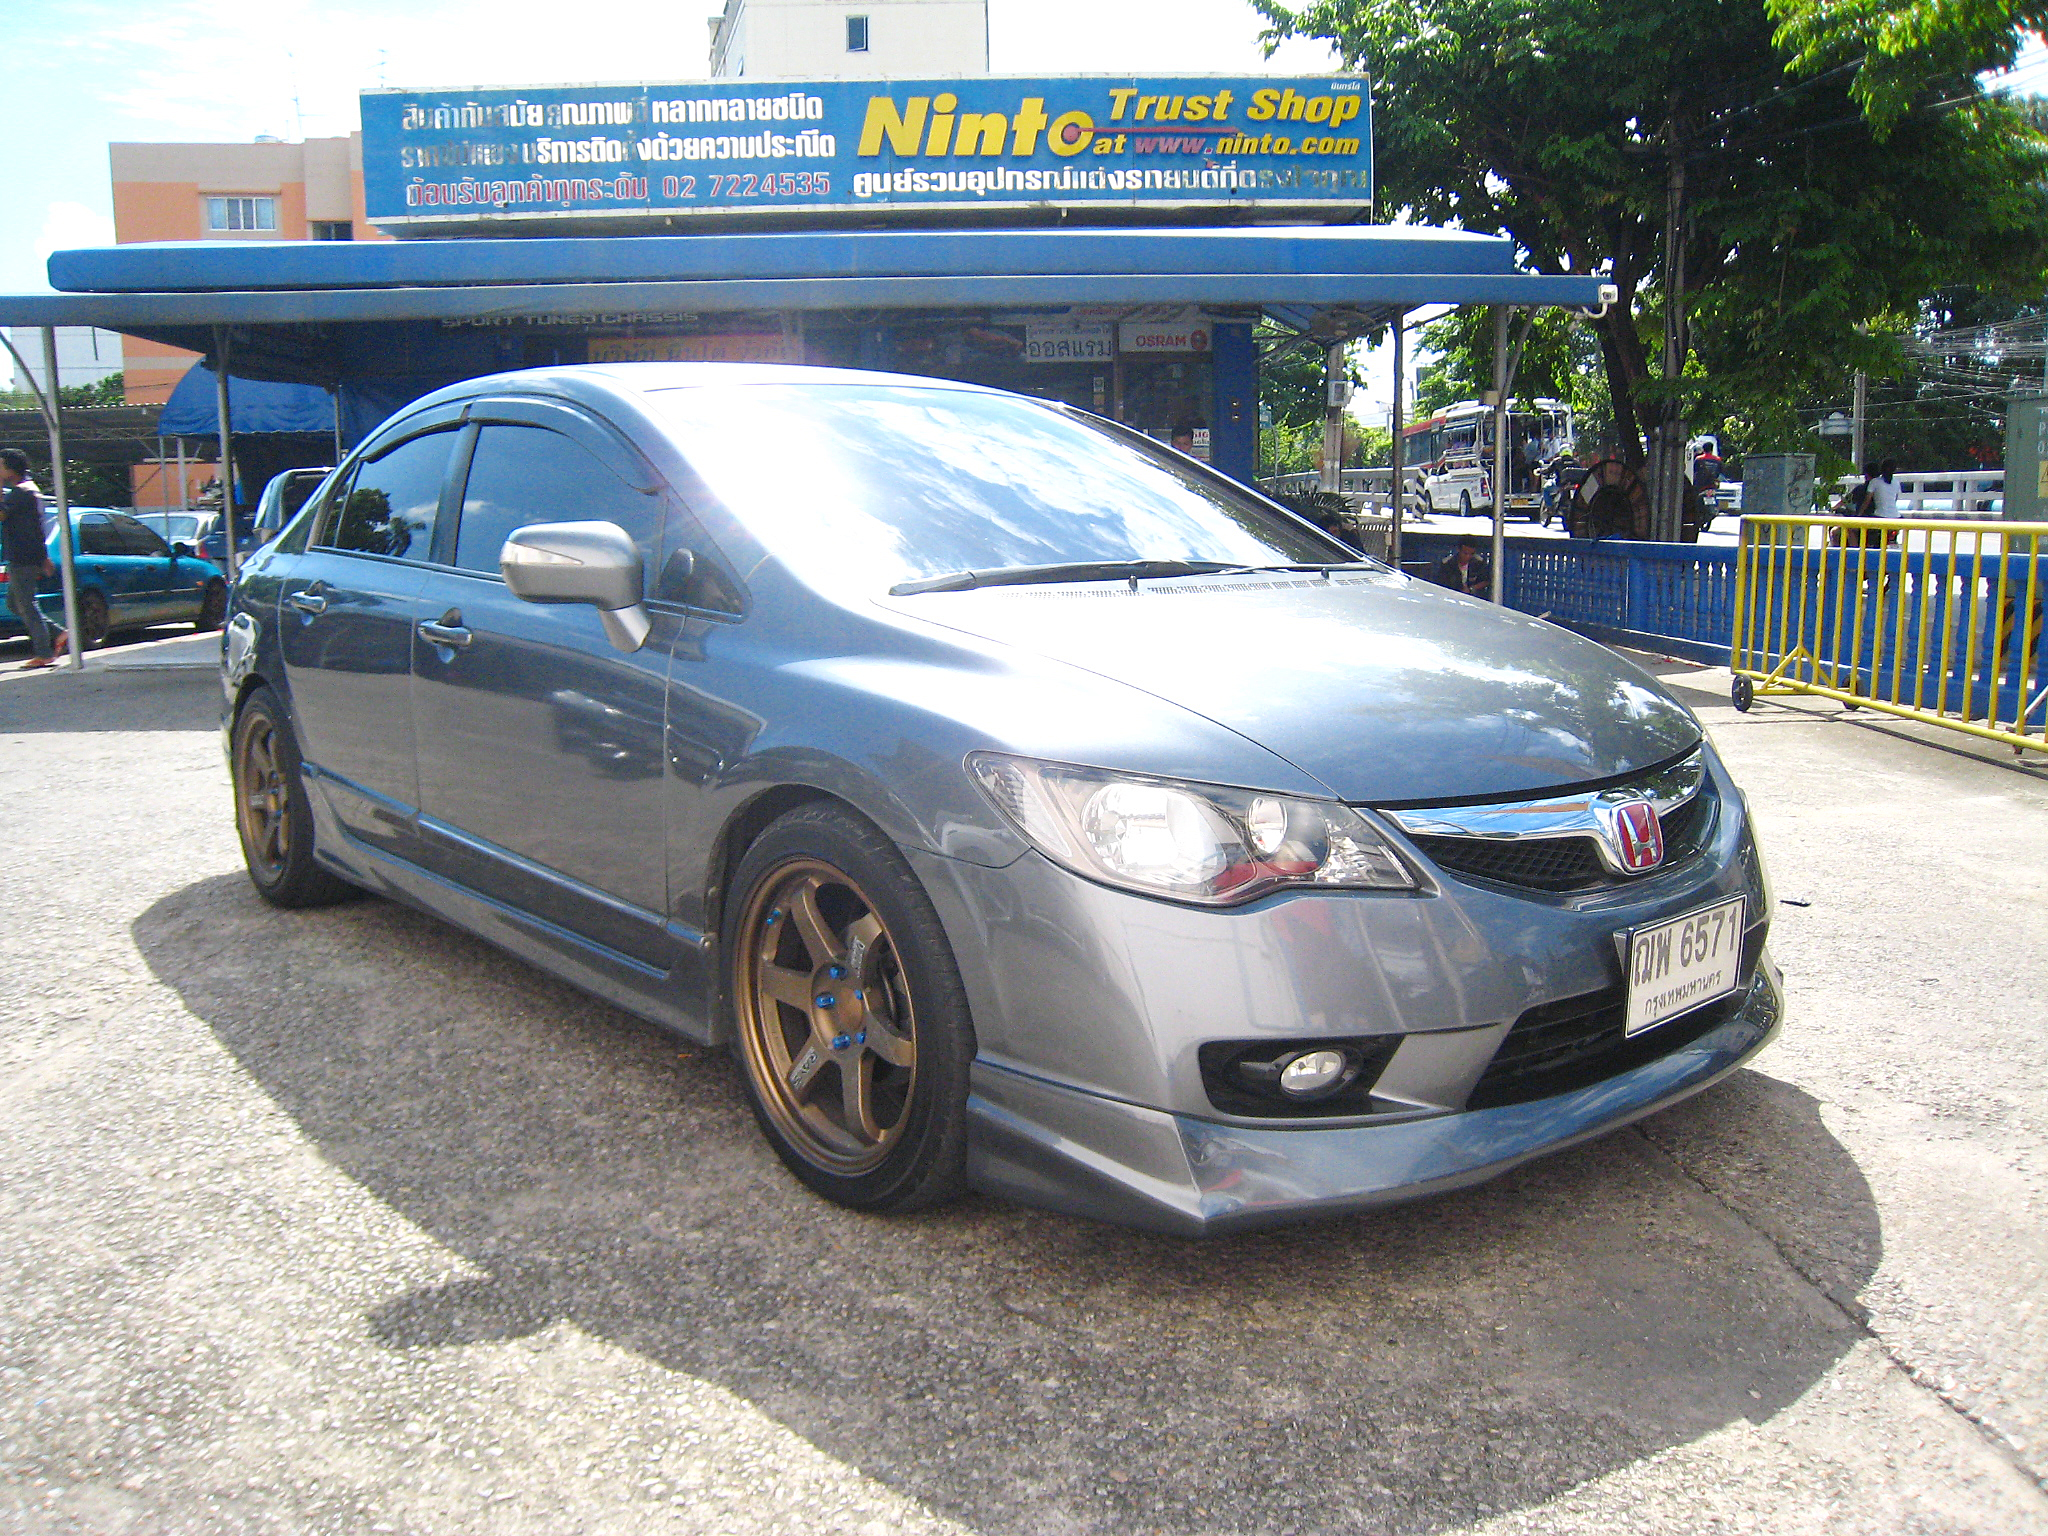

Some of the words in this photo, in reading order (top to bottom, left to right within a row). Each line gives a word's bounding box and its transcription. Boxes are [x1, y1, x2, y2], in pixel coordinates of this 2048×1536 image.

[652, 92, 823, 124] หลากหลายชนิด
[856, 92, 1096, 157] Ninto
[1108, 88, 1234, 121] Trust
[1245, 88, 1361, 128] Shop
[1093, 134, 1127, 155] at
[1134, 132, 1360, 156] www.ninto.com
[406, 171, 648, 208] ต้อนรับลูกค้าทุกระดับ
[662, 174, 696, 199] 02
[708, 171, 831, 198] 7224535
[600, 311, 699, 325] CHASSIS
[1027, 340, 1112, 358] ออสแรม
[1135, 334, 1187, 348] OSRAM
[1679, 906, 1738, 969] 6571
[1644, 969, 1722, 1018] กรุงเทพมหานคร
